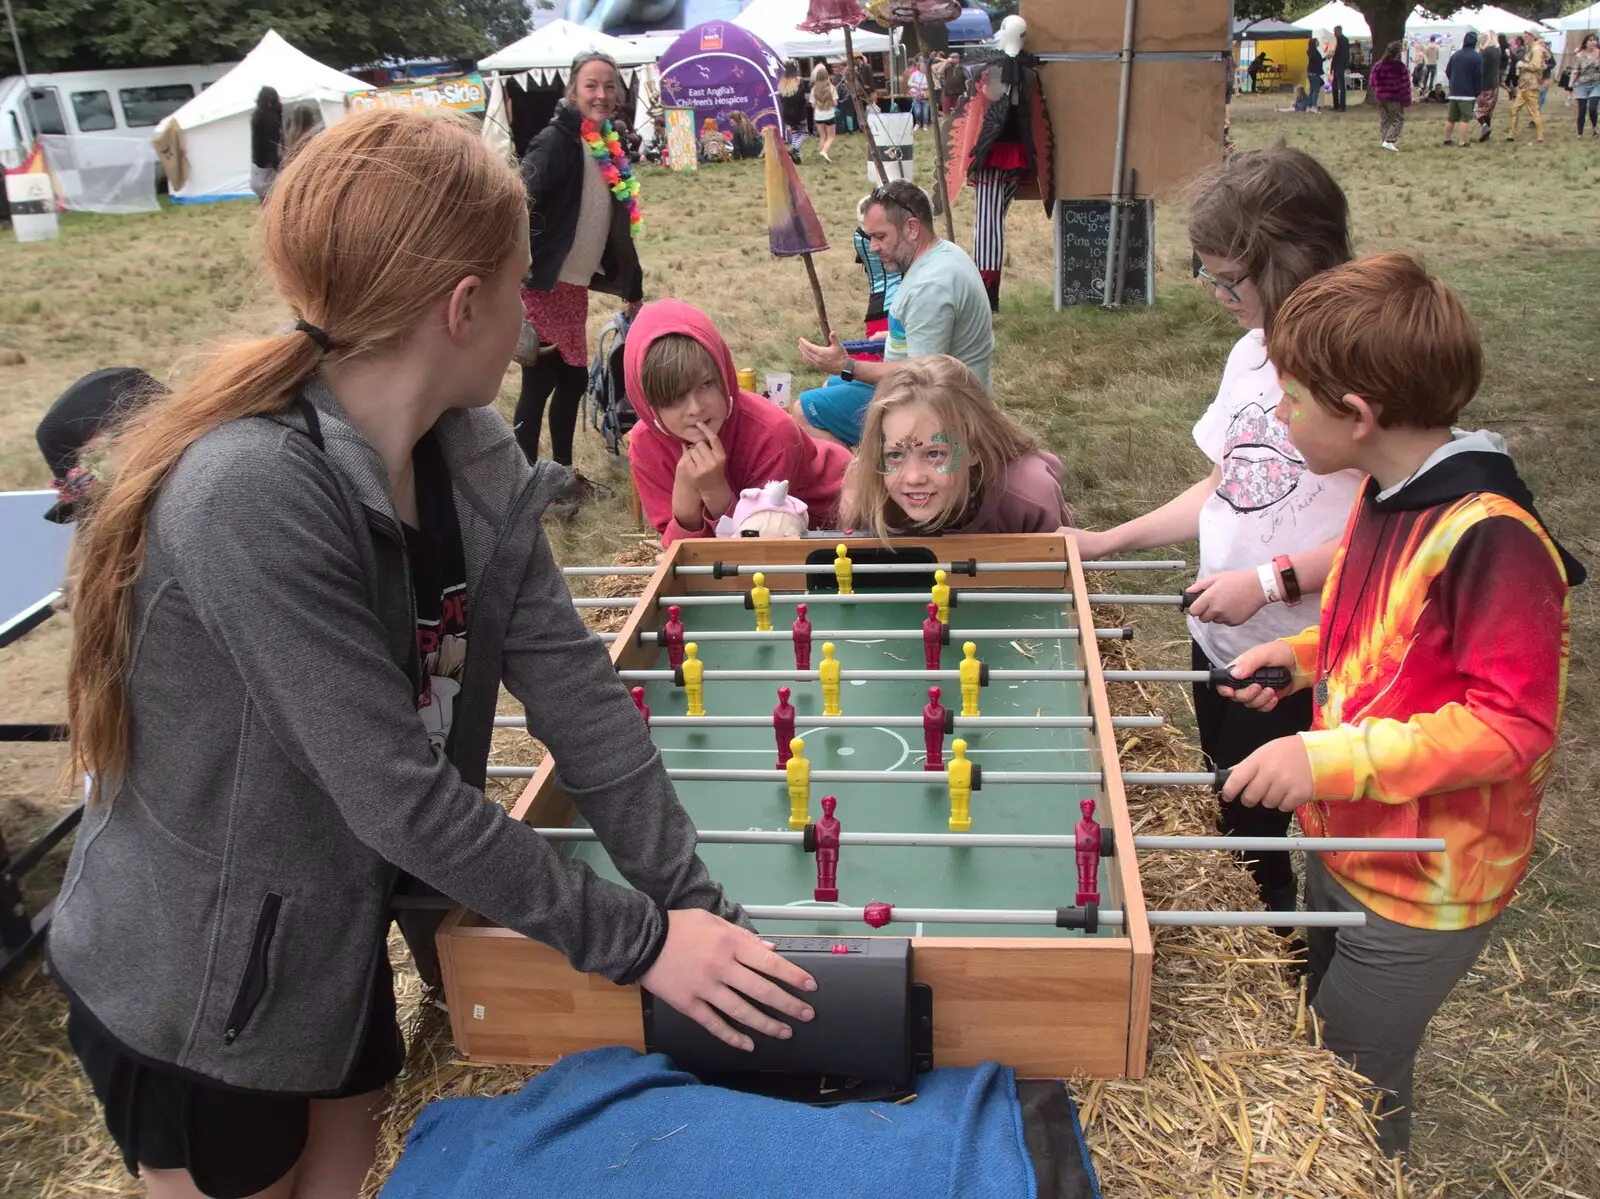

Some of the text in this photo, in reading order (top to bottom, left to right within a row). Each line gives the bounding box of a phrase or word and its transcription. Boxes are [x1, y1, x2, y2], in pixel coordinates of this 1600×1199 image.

[688, 85, 735, 98] East Anglia's
[676, 95, 748, 107] Children's Hospices
[1065, 210, 1088, 225] Clay
[1066, 233, 1090, 247] Pine
[1259, 508, 1283, 543] Je
